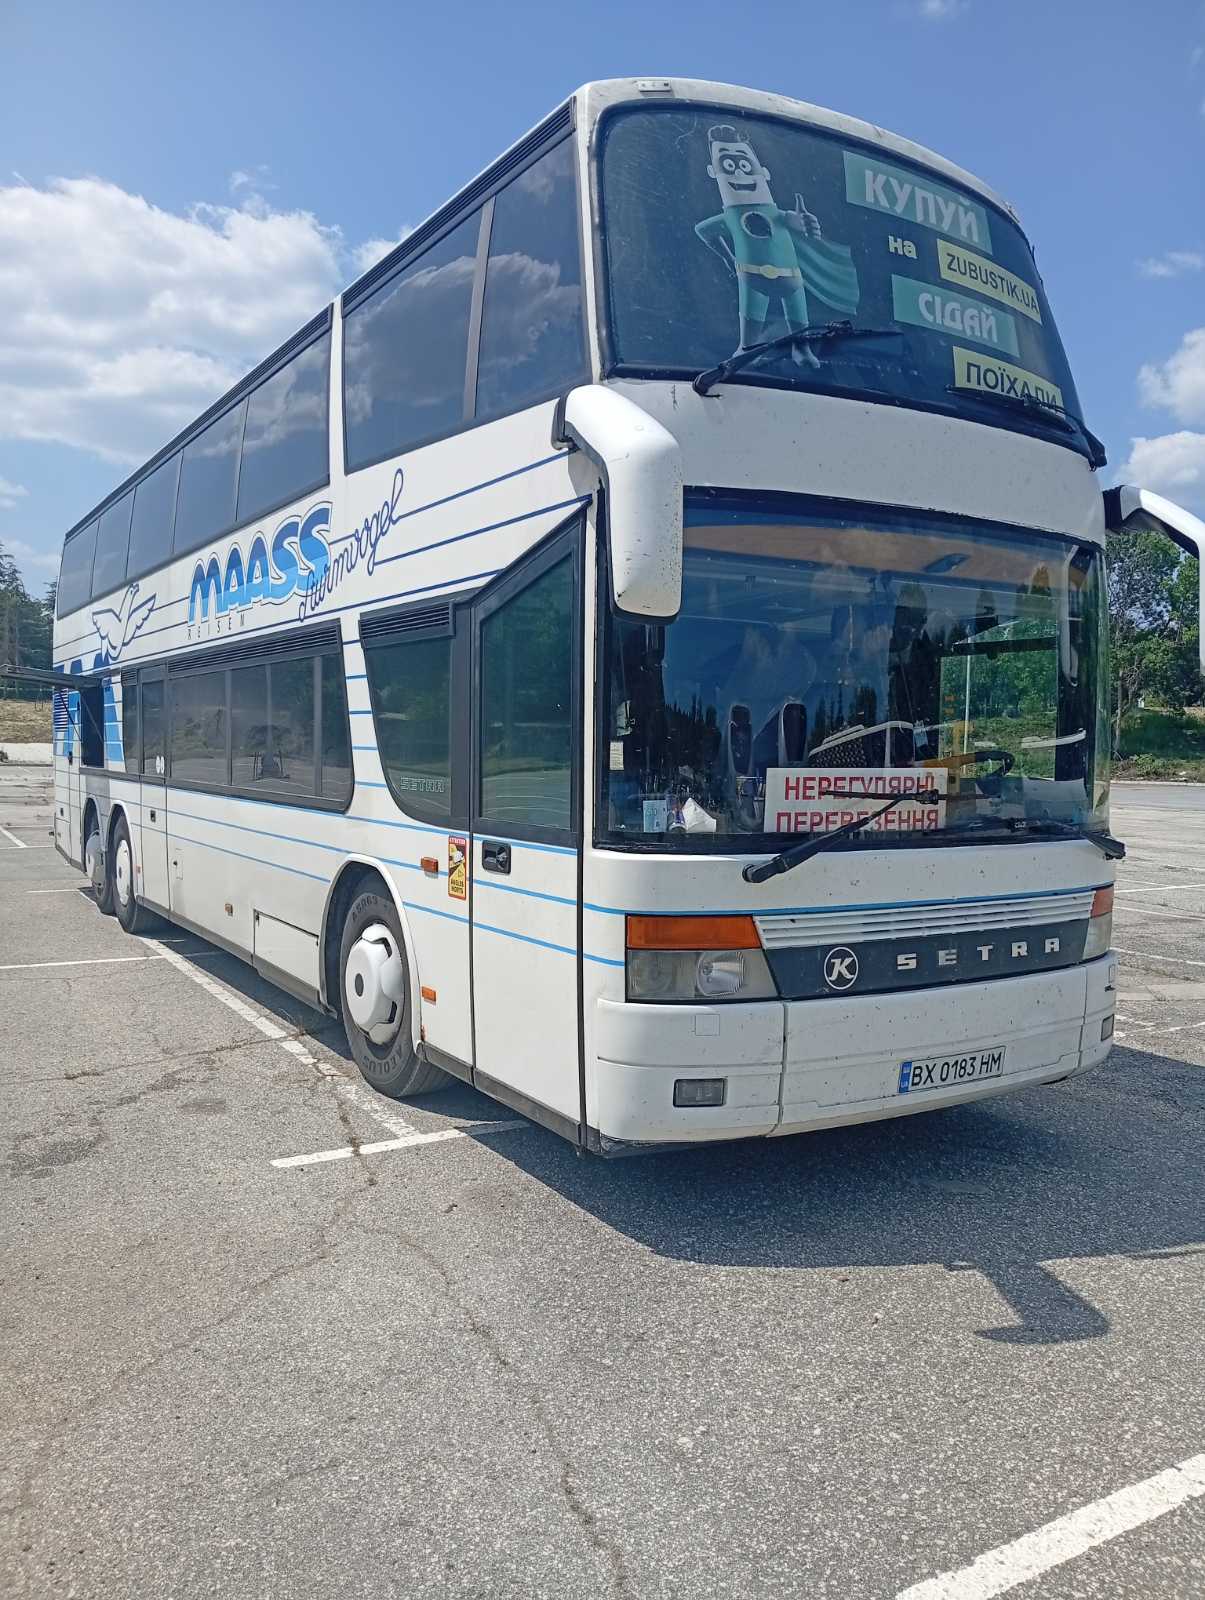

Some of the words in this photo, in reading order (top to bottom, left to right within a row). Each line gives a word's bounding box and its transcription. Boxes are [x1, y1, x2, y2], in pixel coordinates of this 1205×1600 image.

[865, 169, 980, 243] КУПУЙ
[887, 234, 918, 260] на
[946, 252, 1039, 314] ZUBUSTIK.UA
[918, 292, 998, 343] СІДАЙ
[187, 501, 333, 627] MAASS
[896, 937, 1060, 971] SETRA
[911, 1063, 937, 1086] BX
[940, 1056, 976, 1082] 0183
[979, 1052, 1002, 1075] HM
